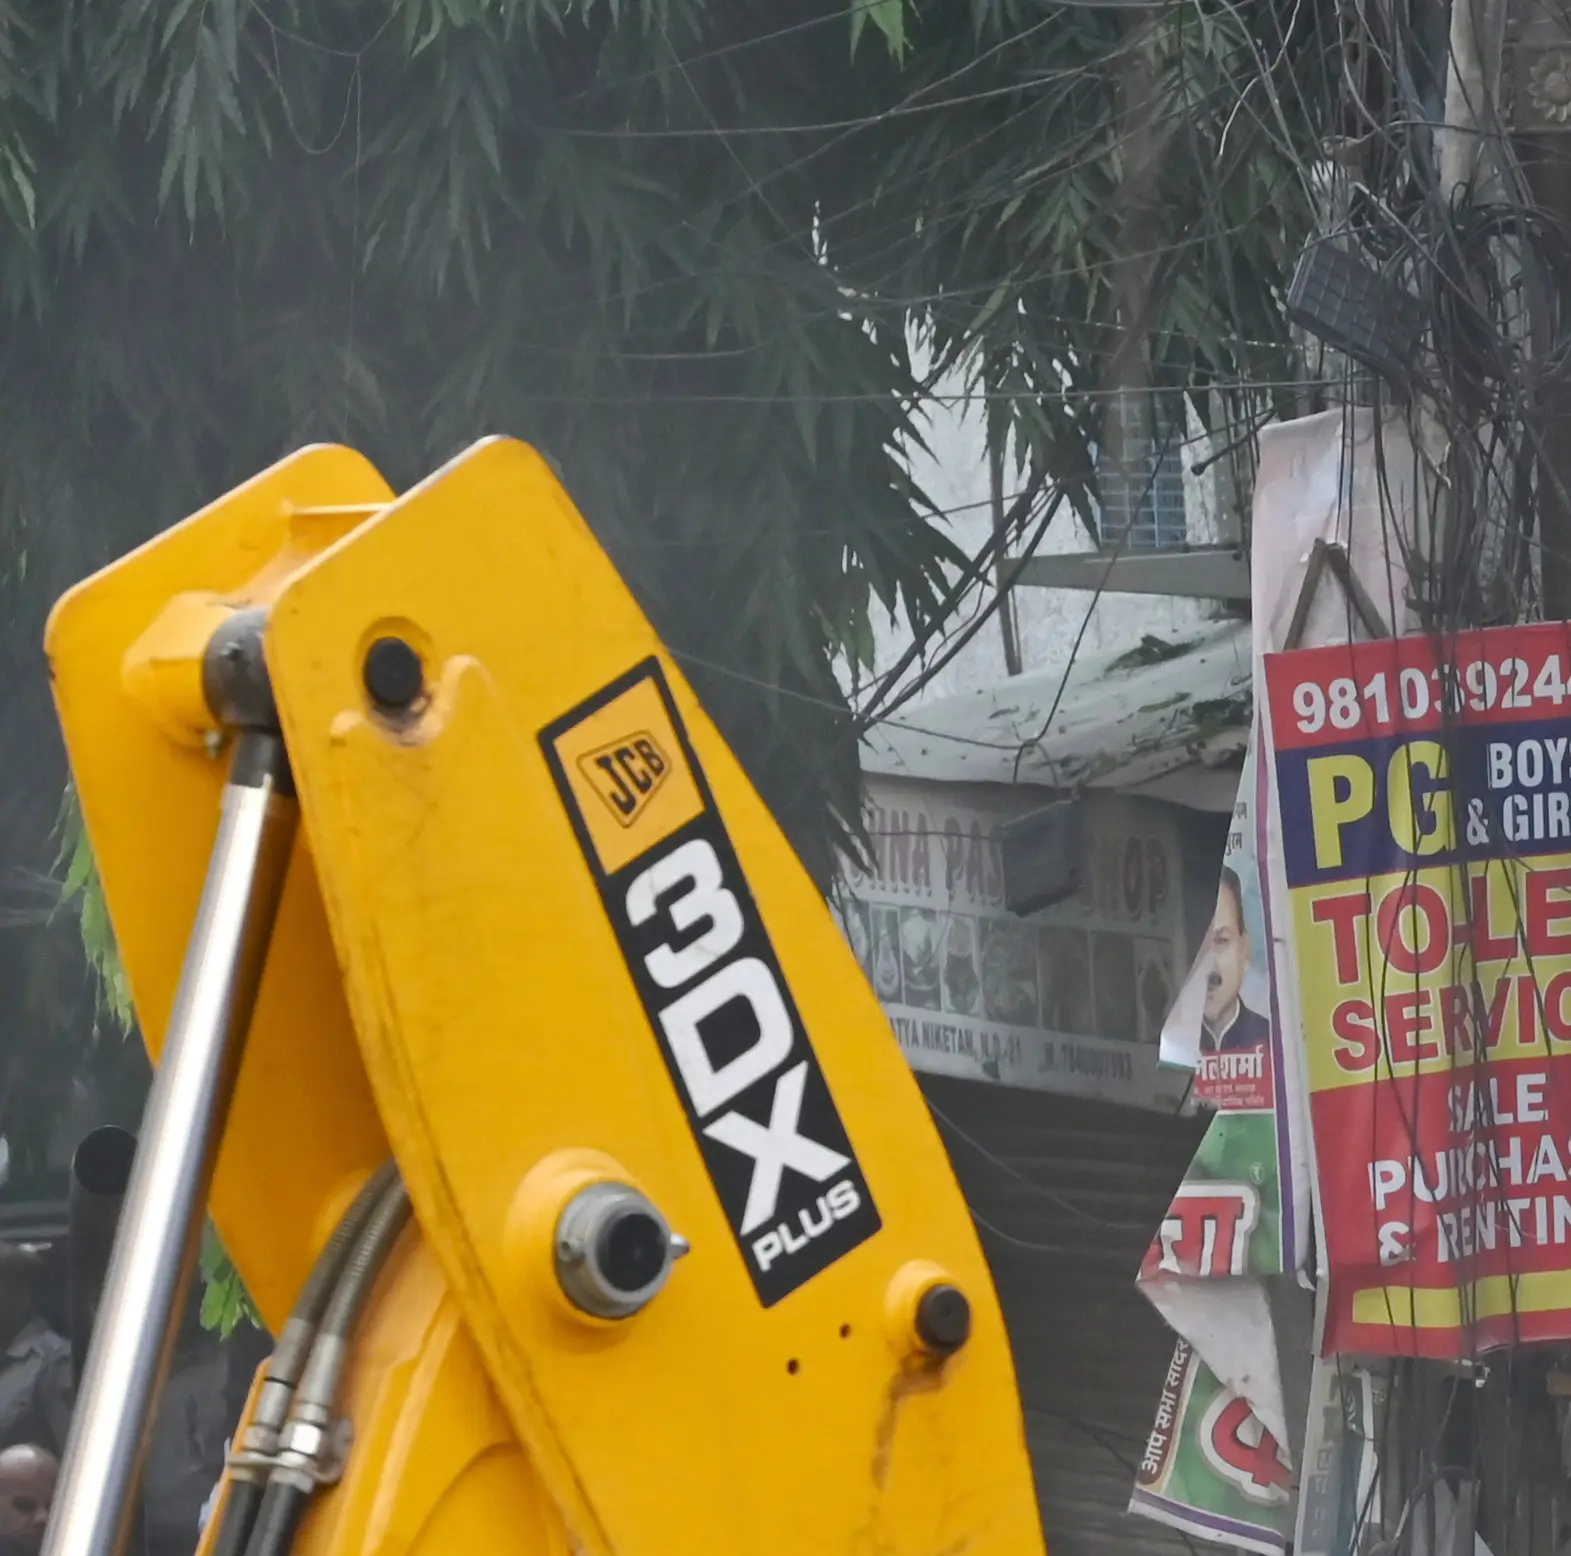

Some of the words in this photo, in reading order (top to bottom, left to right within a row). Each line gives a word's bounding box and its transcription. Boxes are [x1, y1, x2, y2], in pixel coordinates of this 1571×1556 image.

[595, 739, 664, 815] JCB
[1307, 740, 1457, 869] PG
[1467, 798, 1489, 846] &
[626, 839, 852, 1235] 3DX
[1448, 1072, 1548, 1133] SALE
[751, 1179, 861, 1272] PLUS
[1378, 1221, 1415, 1266] &
